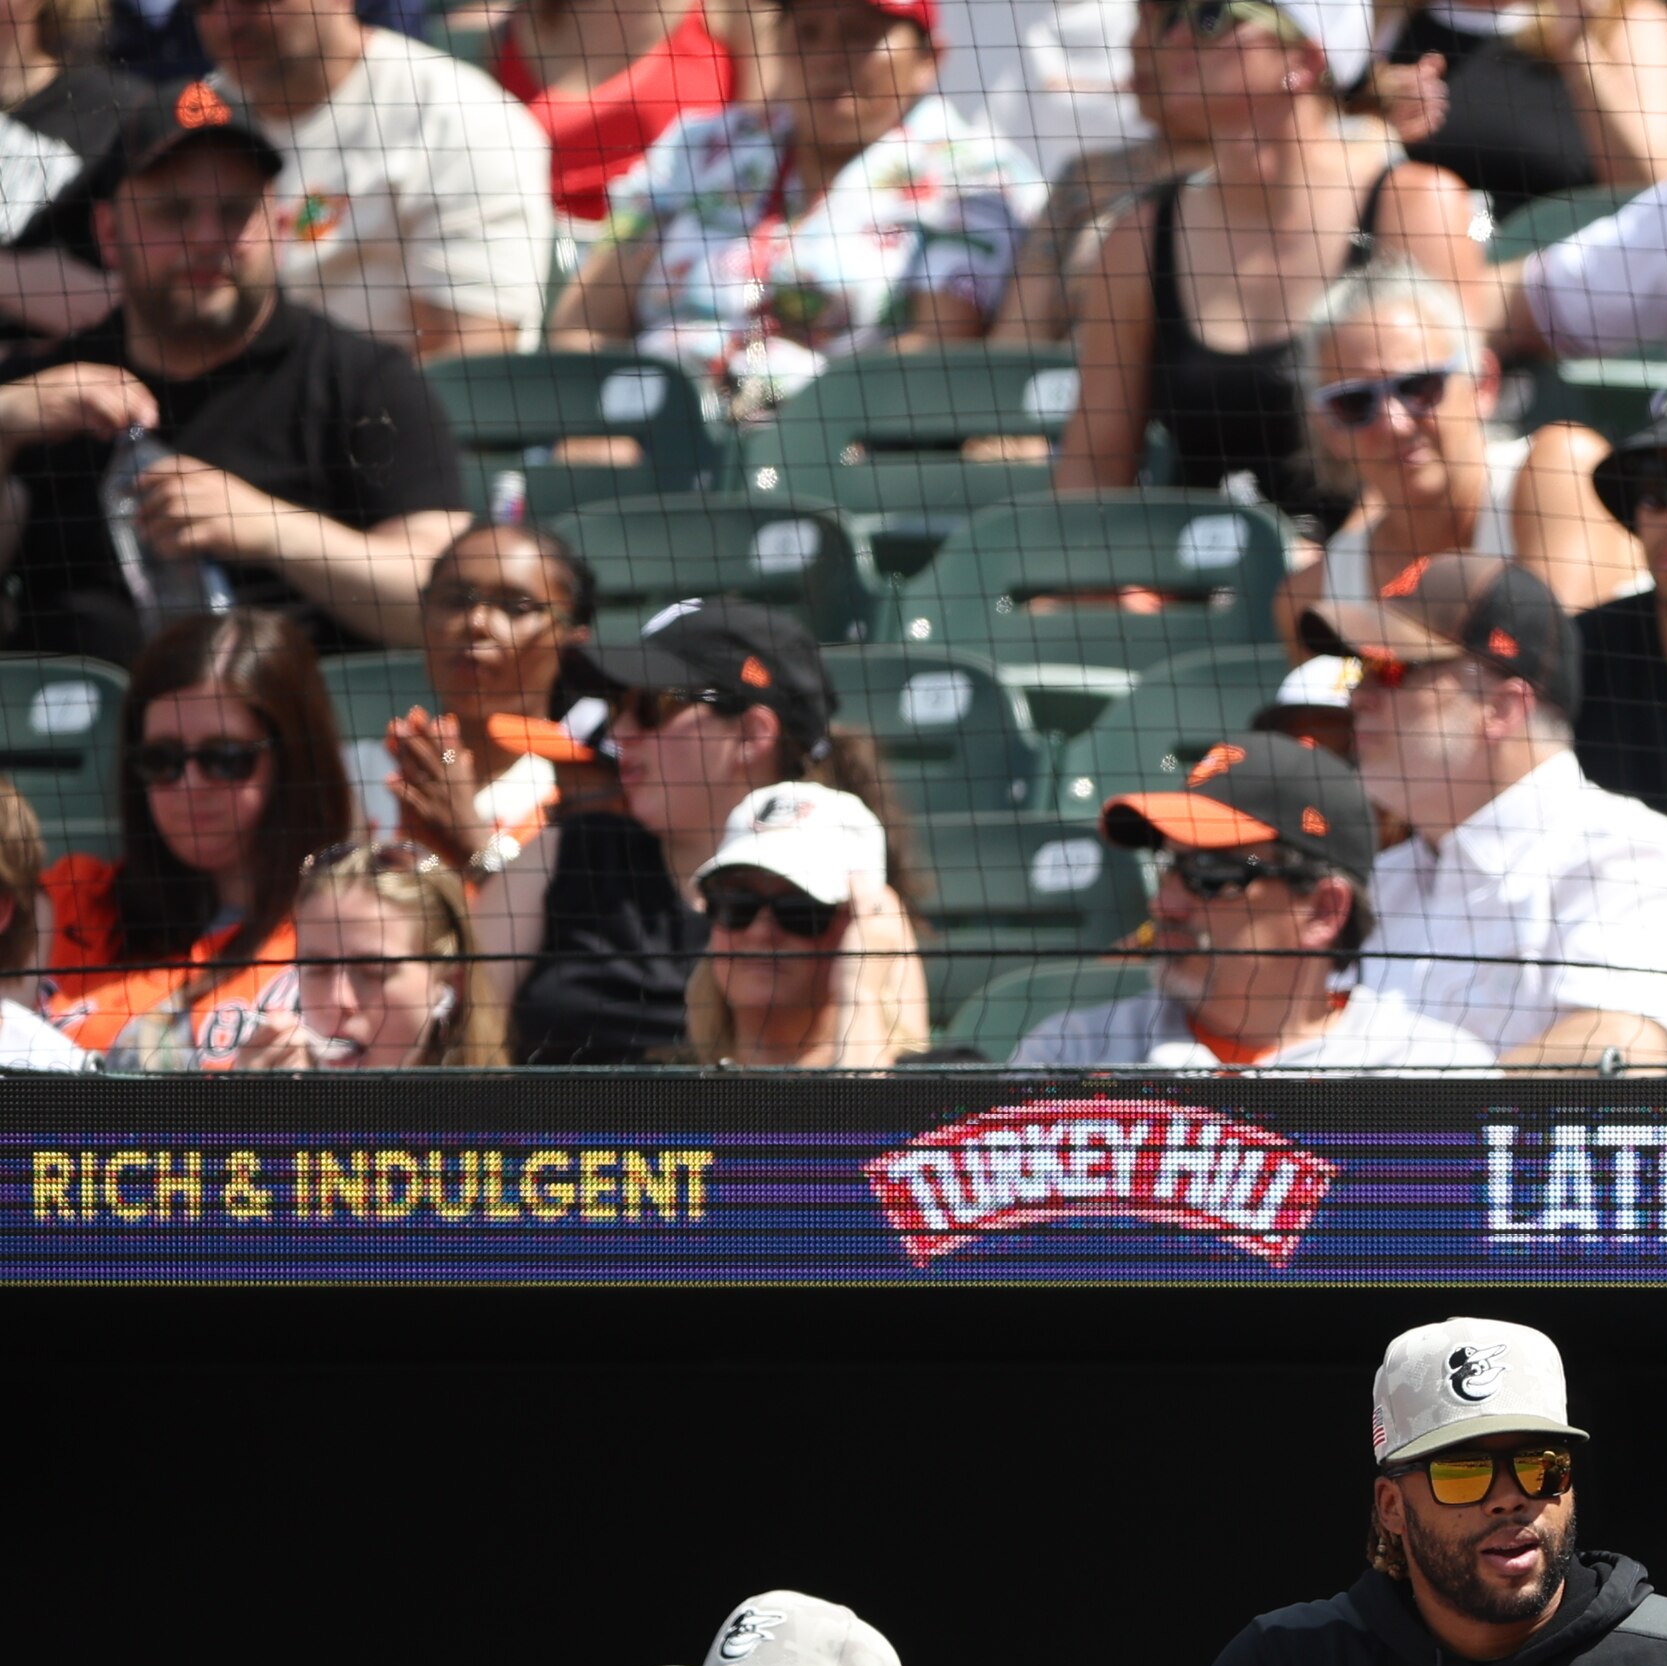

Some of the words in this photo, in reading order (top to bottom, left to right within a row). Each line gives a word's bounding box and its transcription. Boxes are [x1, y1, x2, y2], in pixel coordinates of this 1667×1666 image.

[32, 1150, 202, 1222] RICH
[222, 1150, 272, 1220] &
[295, 1150, 714, 1222] INDULGENT
[886, 1117, 1152, 1232] TURKEY
